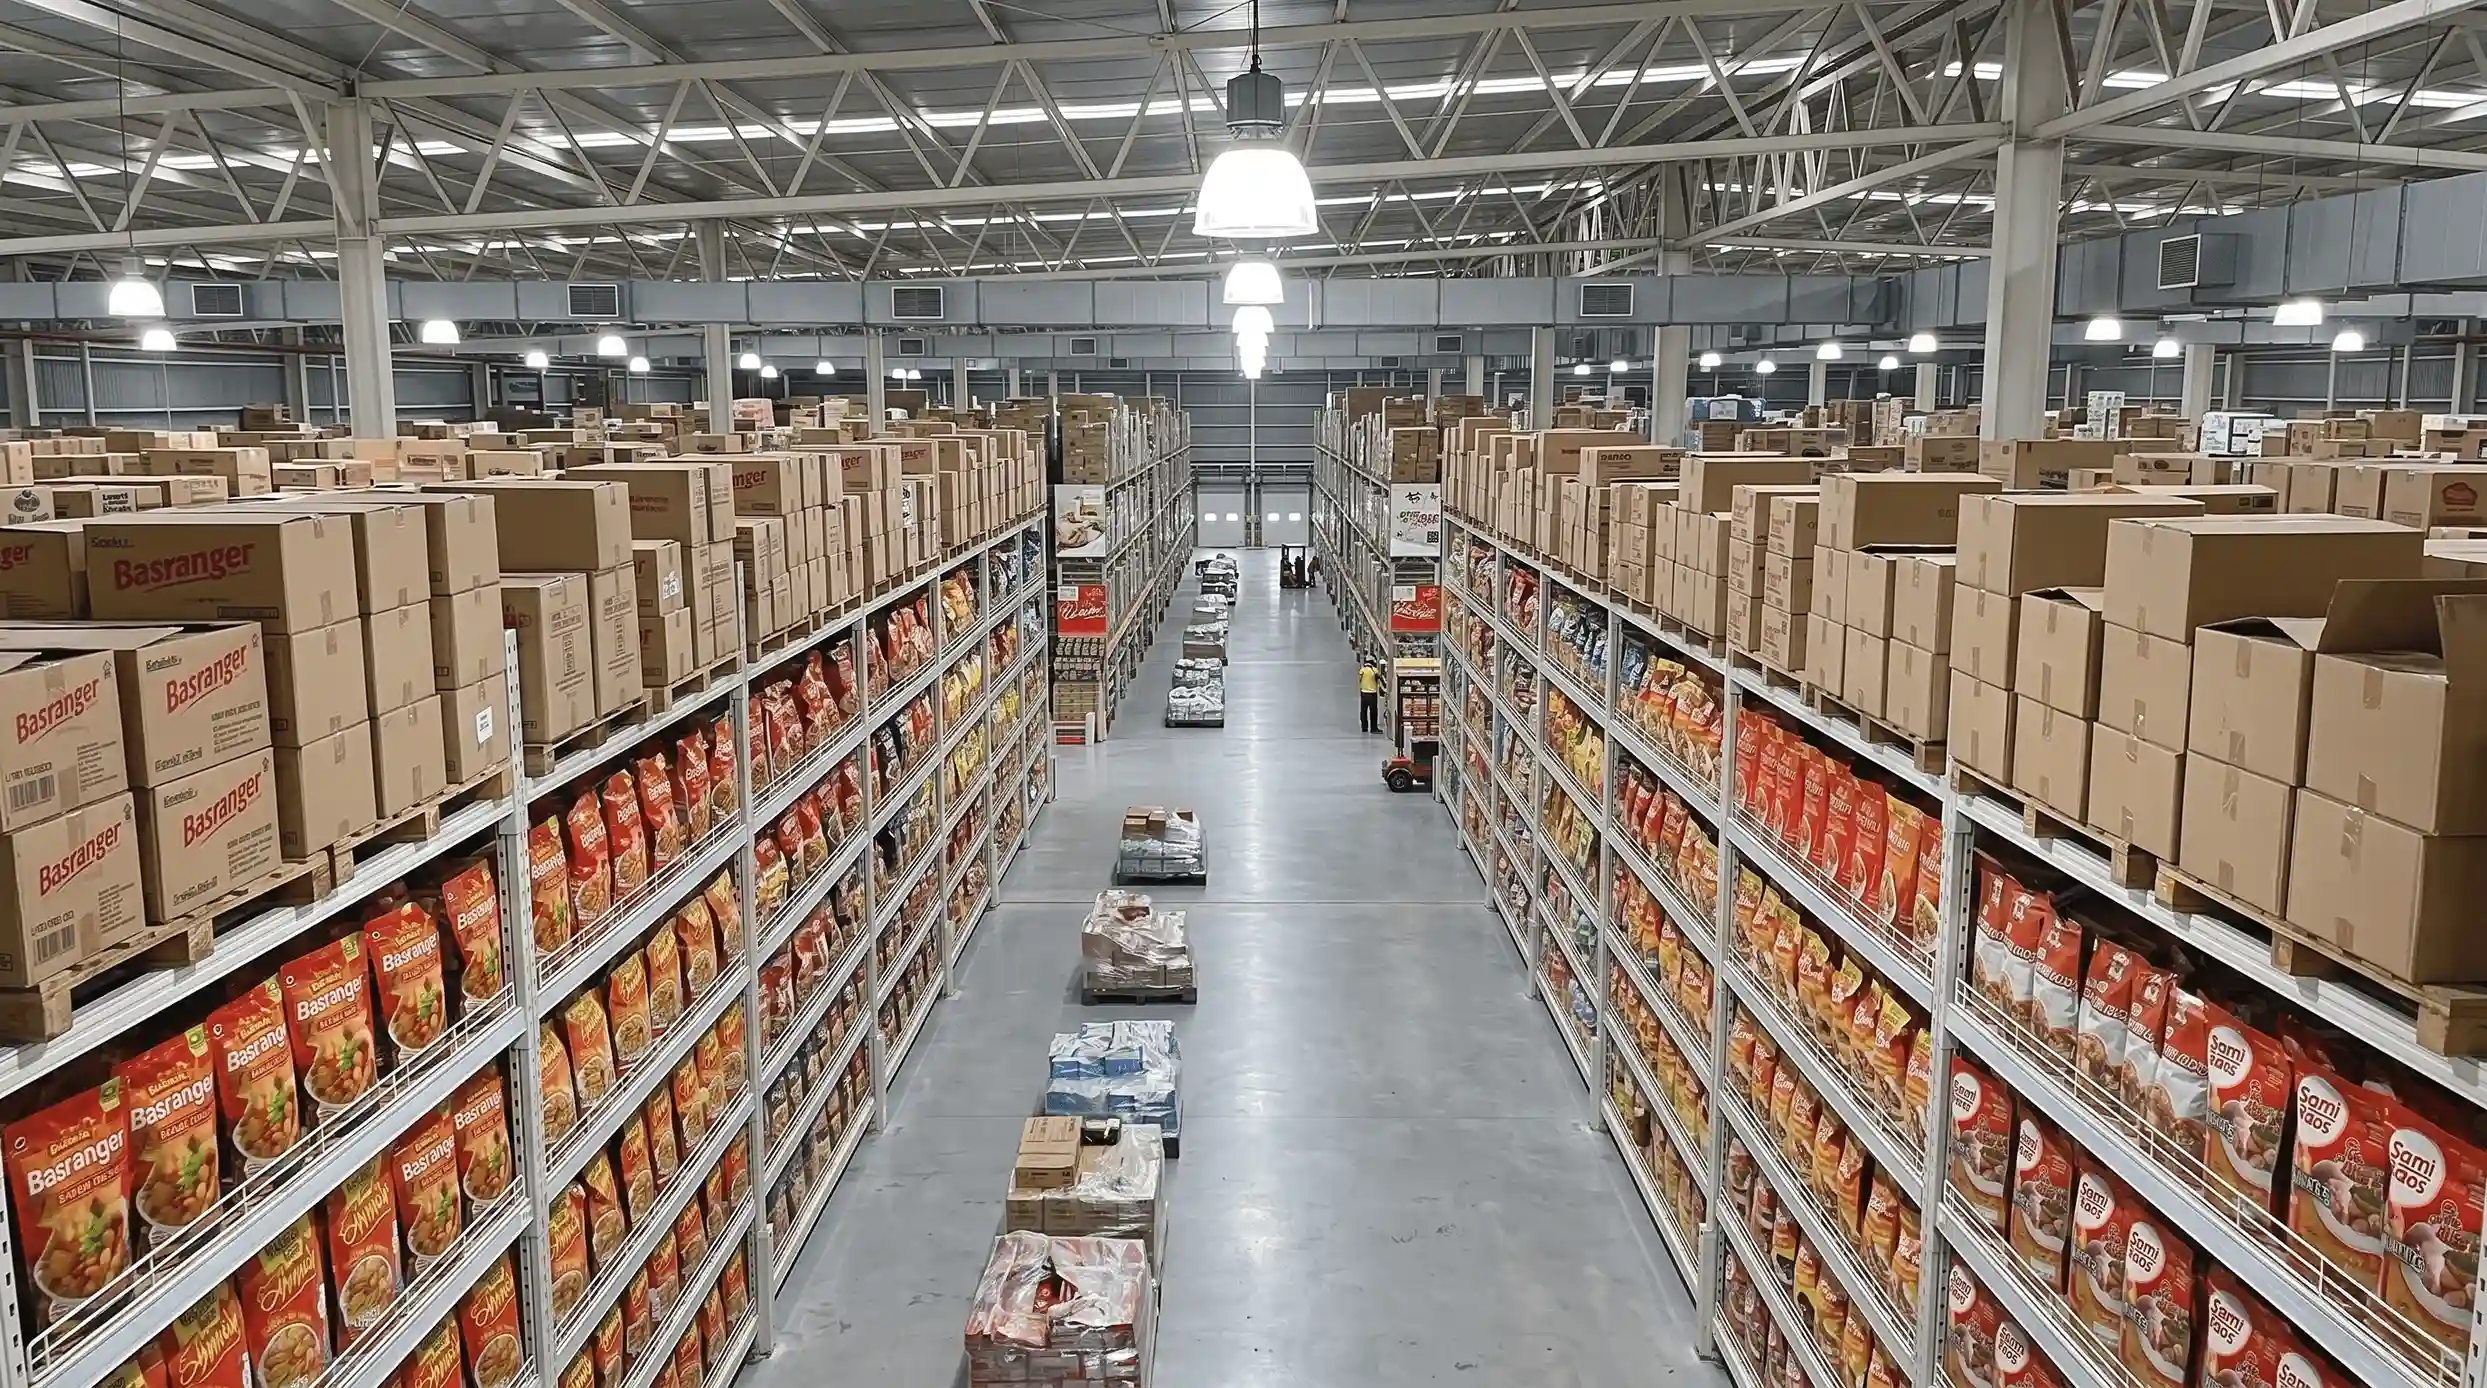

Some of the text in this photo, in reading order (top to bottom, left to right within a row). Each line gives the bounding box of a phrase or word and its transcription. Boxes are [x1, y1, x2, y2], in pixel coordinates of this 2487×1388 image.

[113, 543, 256, 591] Basranger
[166, 644, 248, 715] Basranger
[16, 678, 100, 745] Basranger
[183, 772, 262, 848] Basranger
[39, 821, 123, 897] Basranger
[297, 974, 363, 1021] Basranger
[2210, 1035, 2245, 1062] Sami
[2299, 1086, 2341, 1118] Sami
[27, 1128, 124, 1196] Basranger
[2390, 1141, 2436, 1177] Sami
[2080, 1183, 2109, 1208] Sami
[2129, 1232, 2160, 1260] Sami
[2210, 1299, 2245, 1331] Sami
